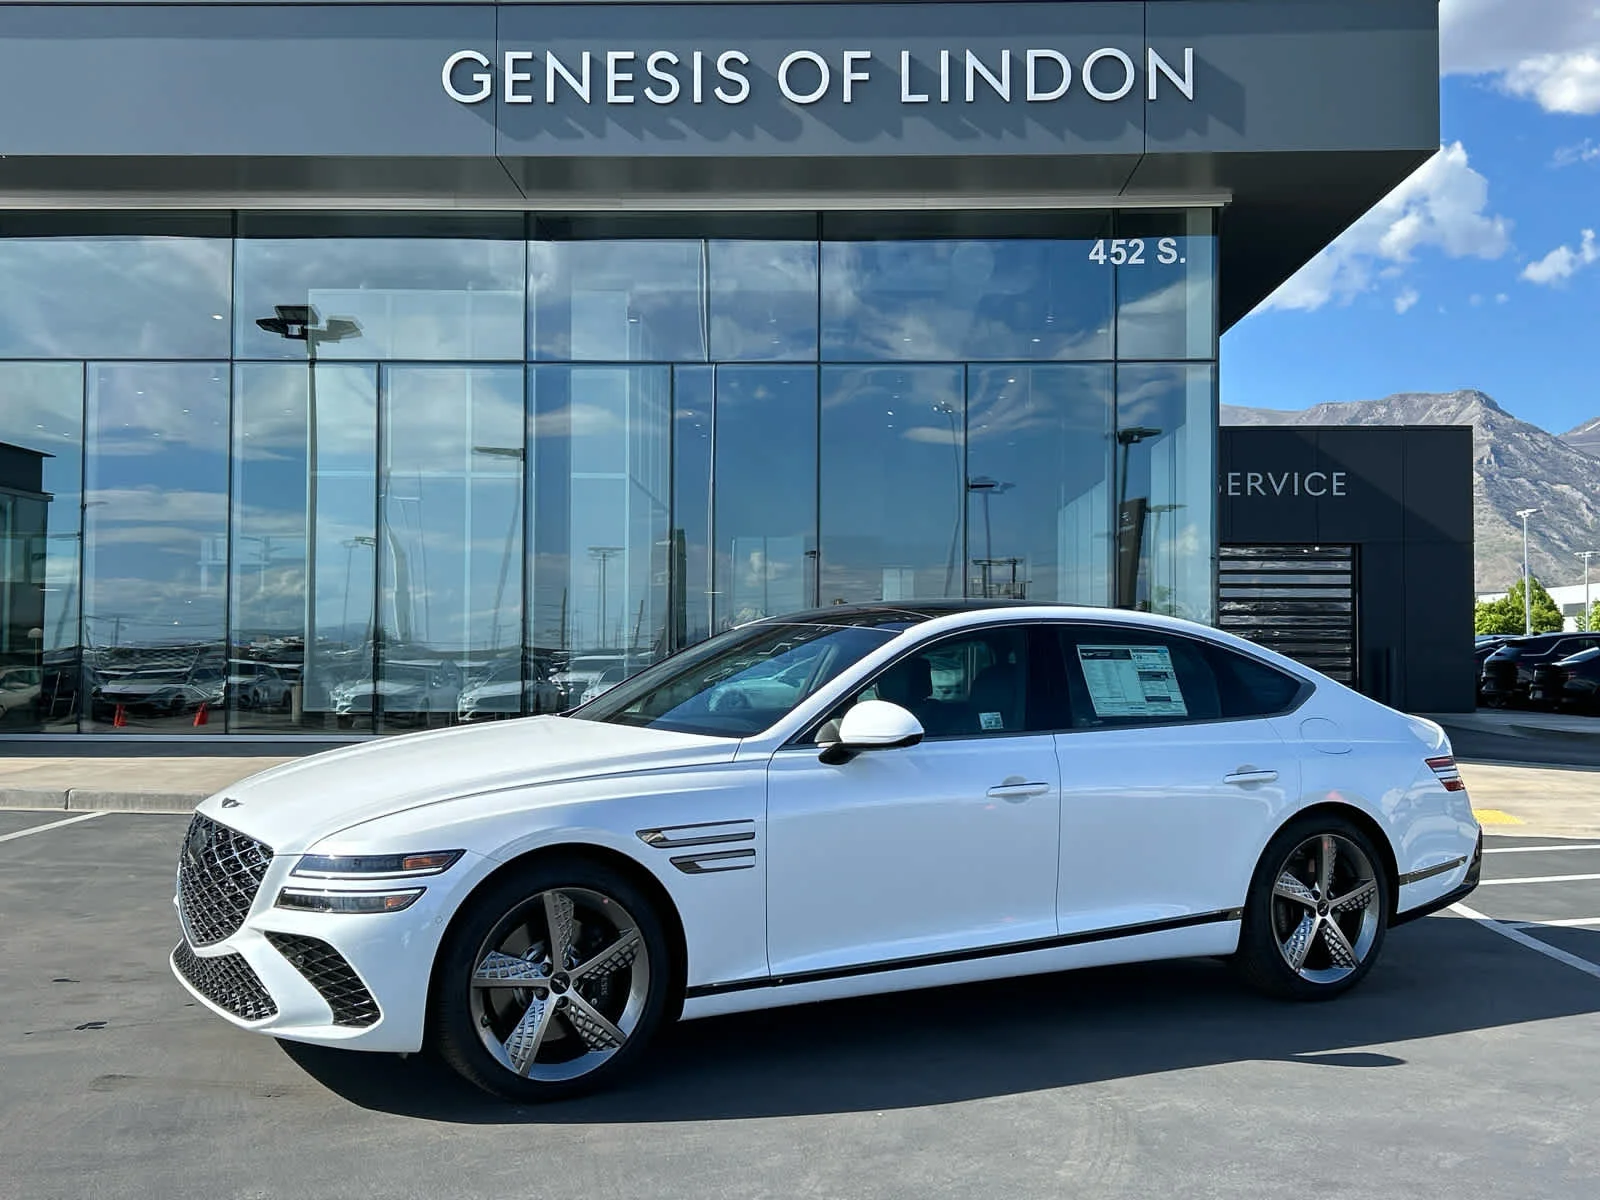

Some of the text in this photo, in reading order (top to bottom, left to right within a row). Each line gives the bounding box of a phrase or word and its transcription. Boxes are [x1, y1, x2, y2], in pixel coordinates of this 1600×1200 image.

[441, 46, 1194, 104] GENESIS OF LINDON
[1088, 237, 1187, 265] 452 S.
